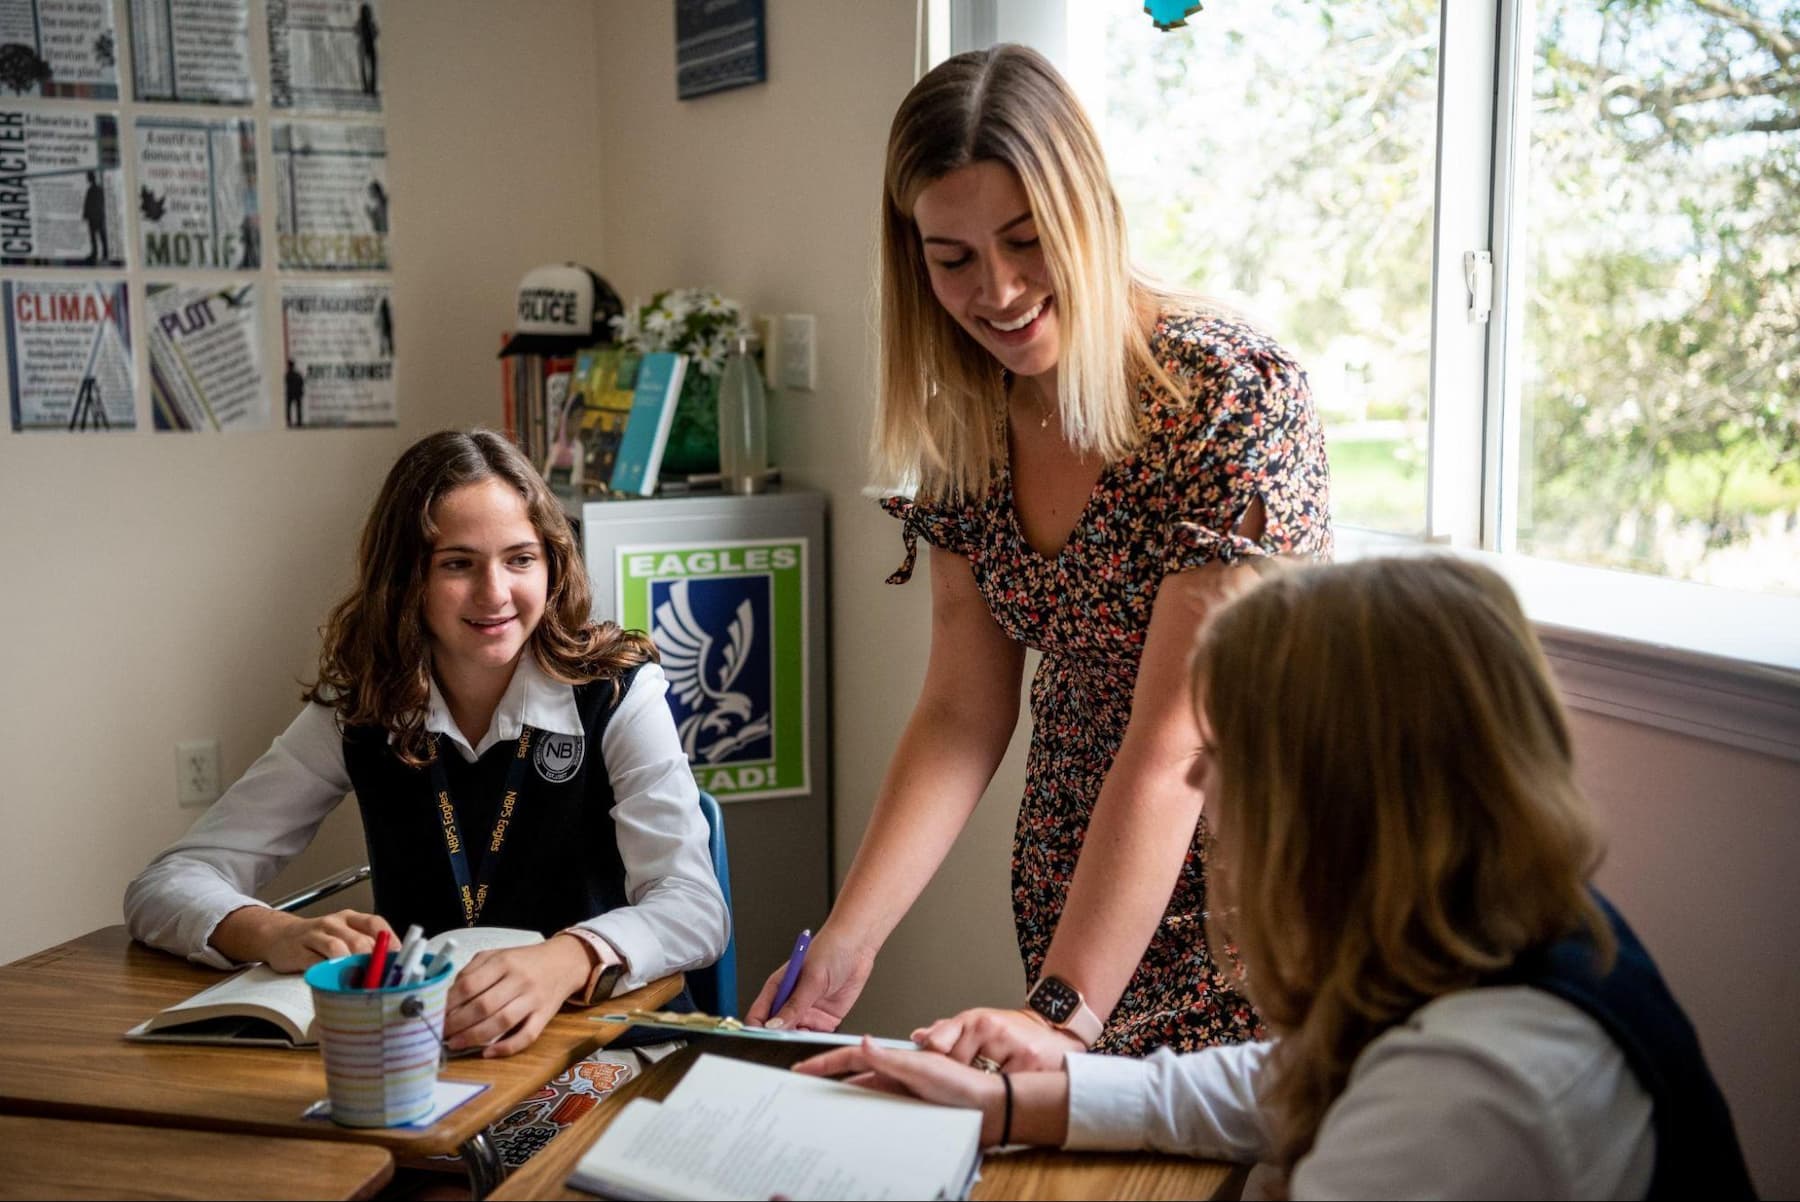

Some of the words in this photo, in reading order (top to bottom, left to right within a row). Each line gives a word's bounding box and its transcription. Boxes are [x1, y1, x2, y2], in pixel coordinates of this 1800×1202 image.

[0, 111, 33, 254] CHARACTER
[145, 231, 236, 267] MOTIF
[17, 291, 117, 323] CLIMAX
[159, 299, 216, 341] PLOT
[629, 548, 797, 577] EAGLES
[517, 726, 535, 759] Eagles
[546, 742, 573, 759] NB
[695, 766, 777, 791] AD!
[439, 791, 454, 826] Eagles
[500, 790, 517, 818] NBPS
[445, 826, 460, 853] NBPS
[491, 819, 509, 852] Eagles
[462, 885, 475, 920] Eagles
[474, 884, 488, 911] NBPS
